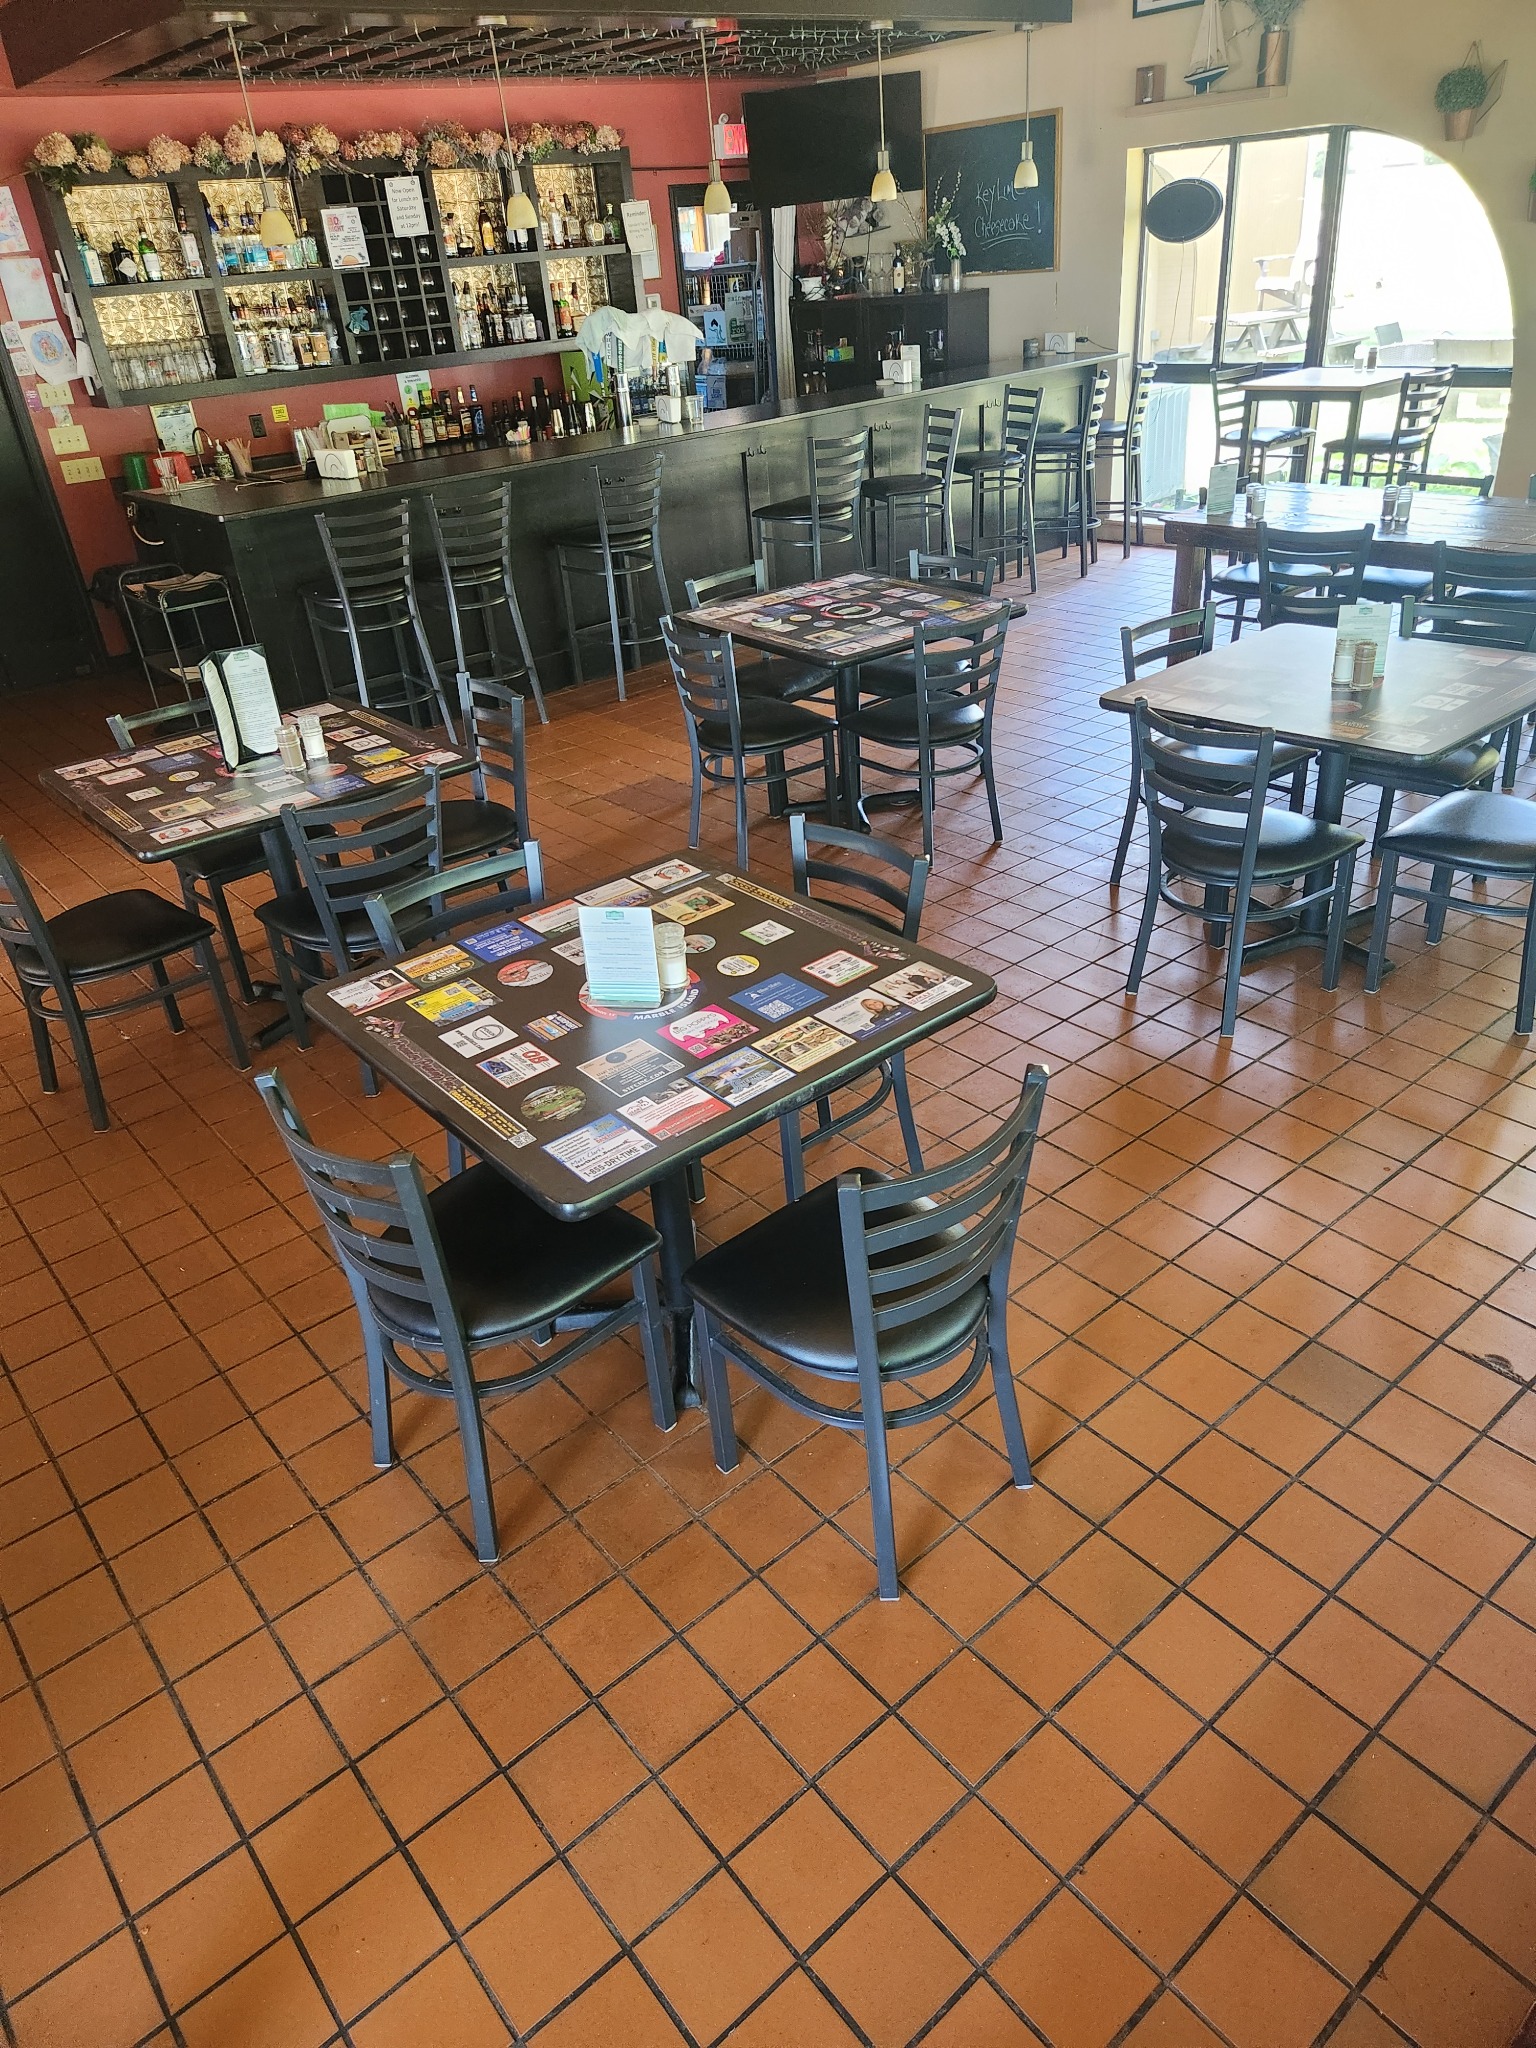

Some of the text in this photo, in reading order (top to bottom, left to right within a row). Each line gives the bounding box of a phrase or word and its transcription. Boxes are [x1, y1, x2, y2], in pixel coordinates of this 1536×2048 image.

[405, 213, 420, 221] Sunday
[633, 1008, 676, 1020] MARBLE
[678, 988, 699, 1009] ISLAND
[582, 1145, 640, 1177] 1-855-DRY-TIME
